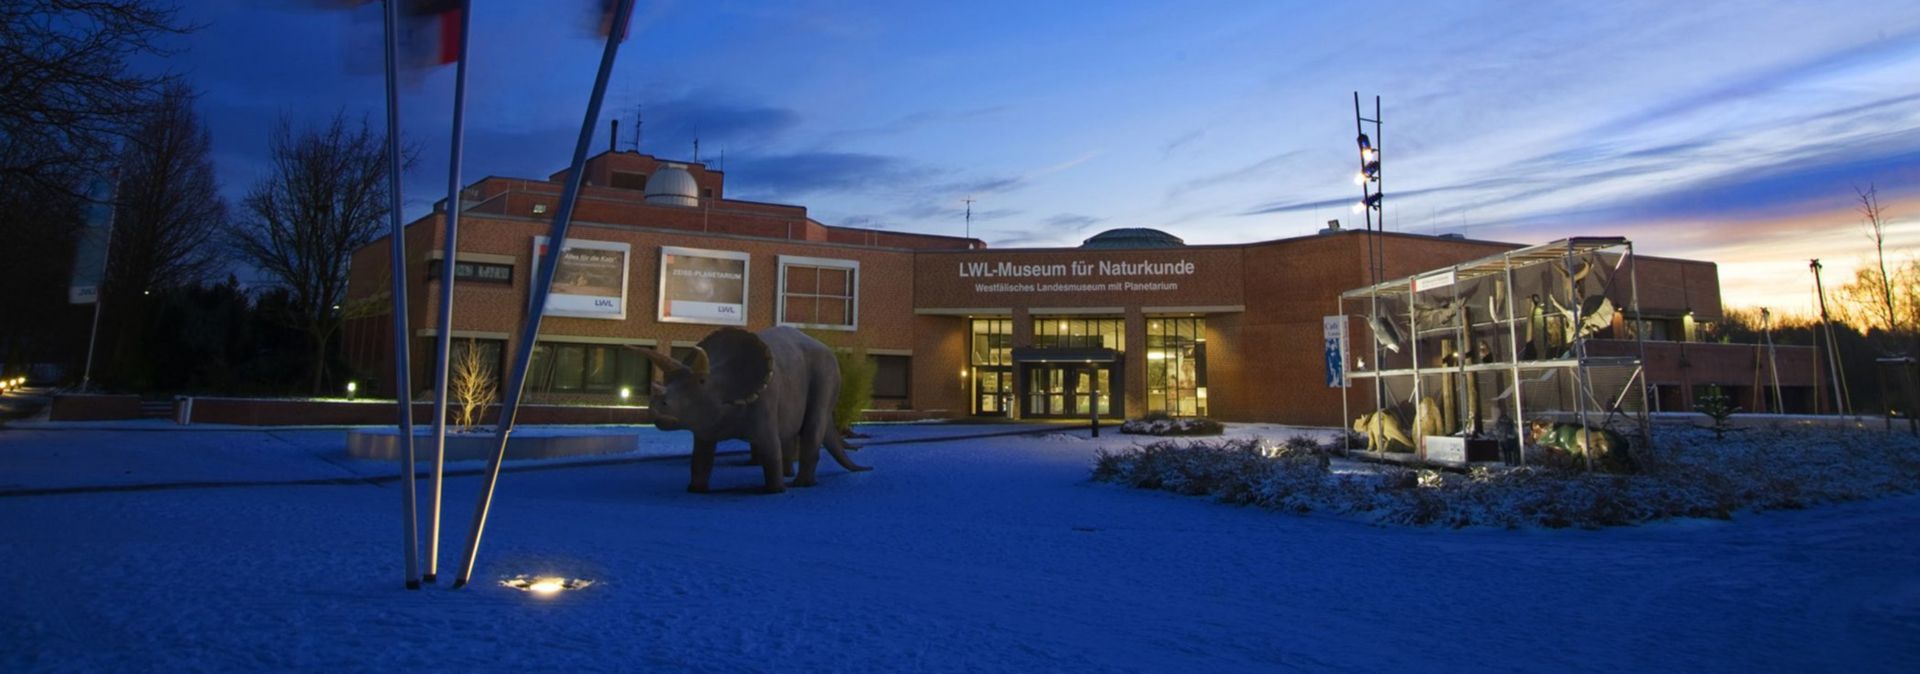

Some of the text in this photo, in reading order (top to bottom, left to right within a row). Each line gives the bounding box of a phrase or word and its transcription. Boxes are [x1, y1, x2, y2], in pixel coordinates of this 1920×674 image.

[959, 259, 1195, 277] LWL-Museum für Naturkunde
[975, 281, 1178, 293] Westfälisches Landesmuseum mit Planetarium
[595, 299, 614, 308] LWL
[718, 306, 735, 314] LWL
